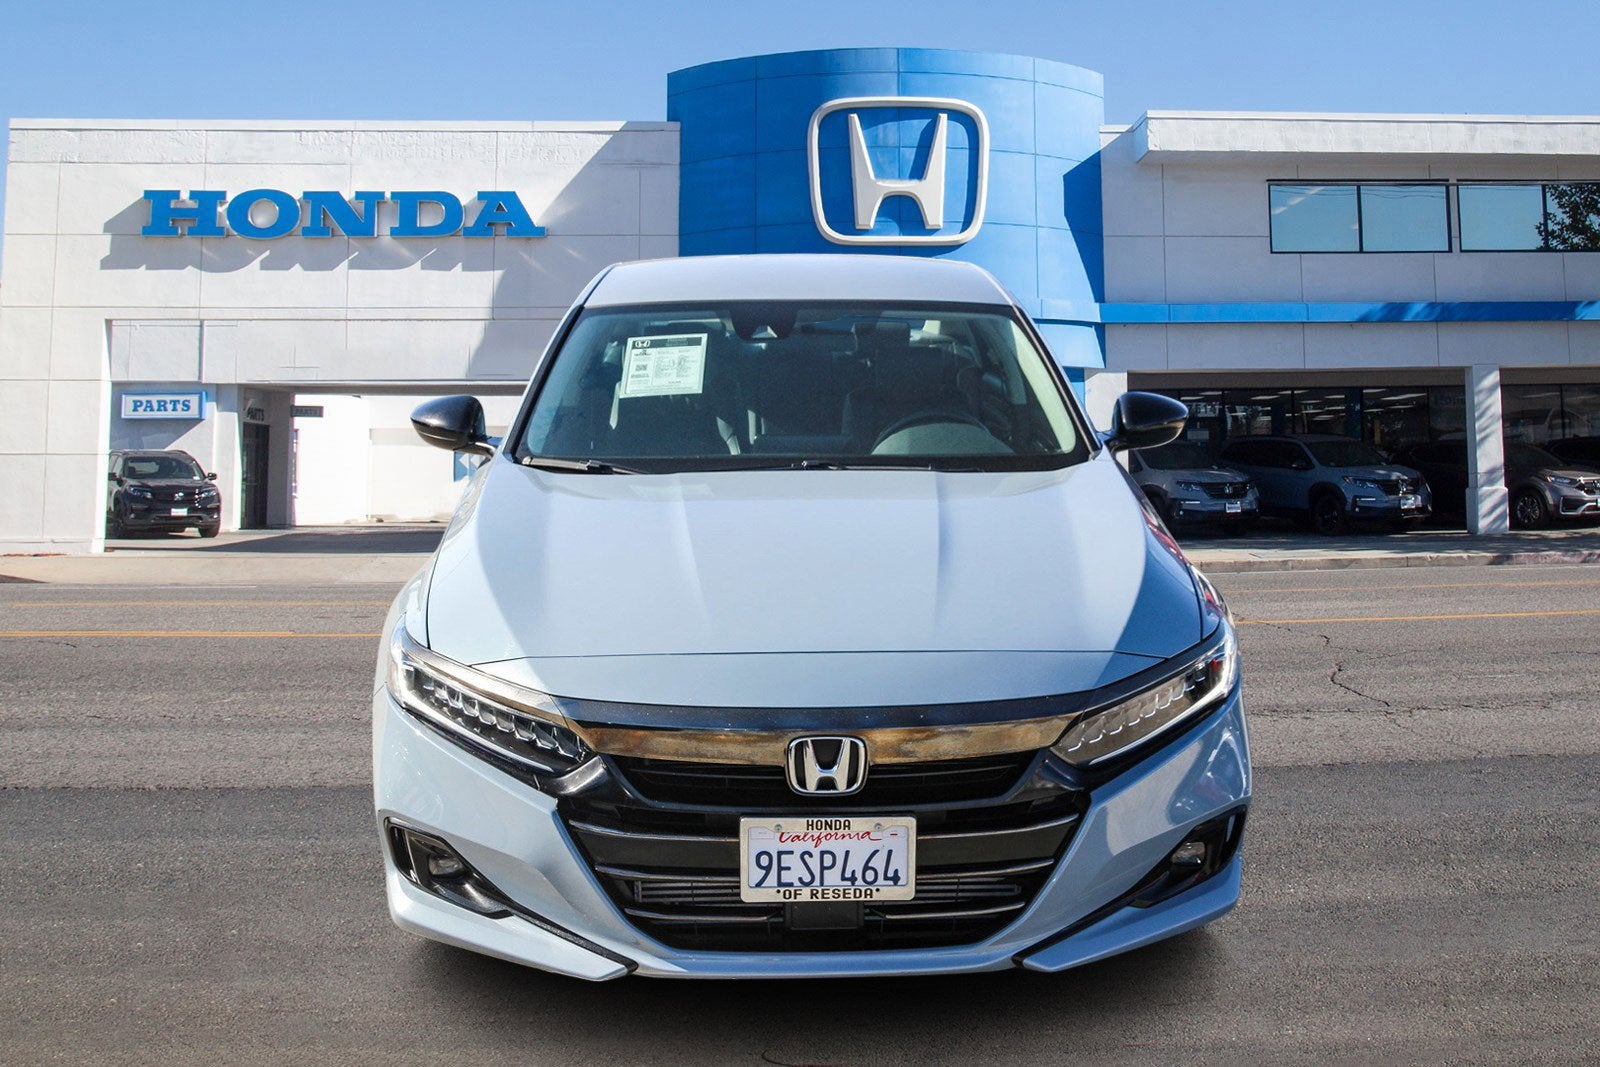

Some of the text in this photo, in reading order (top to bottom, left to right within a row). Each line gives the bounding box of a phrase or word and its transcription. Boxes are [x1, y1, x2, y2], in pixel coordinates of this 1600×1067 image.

[141, 189, 547, 239] HONDA
[132, 399, 191, 412] PARTS
[806, 819, 851, 831] HONDA
[779, 831, 882, 848] California
[755, 849, 901, 887] 9ESP464
[782, 888, 874, 900] OF RESEDA
